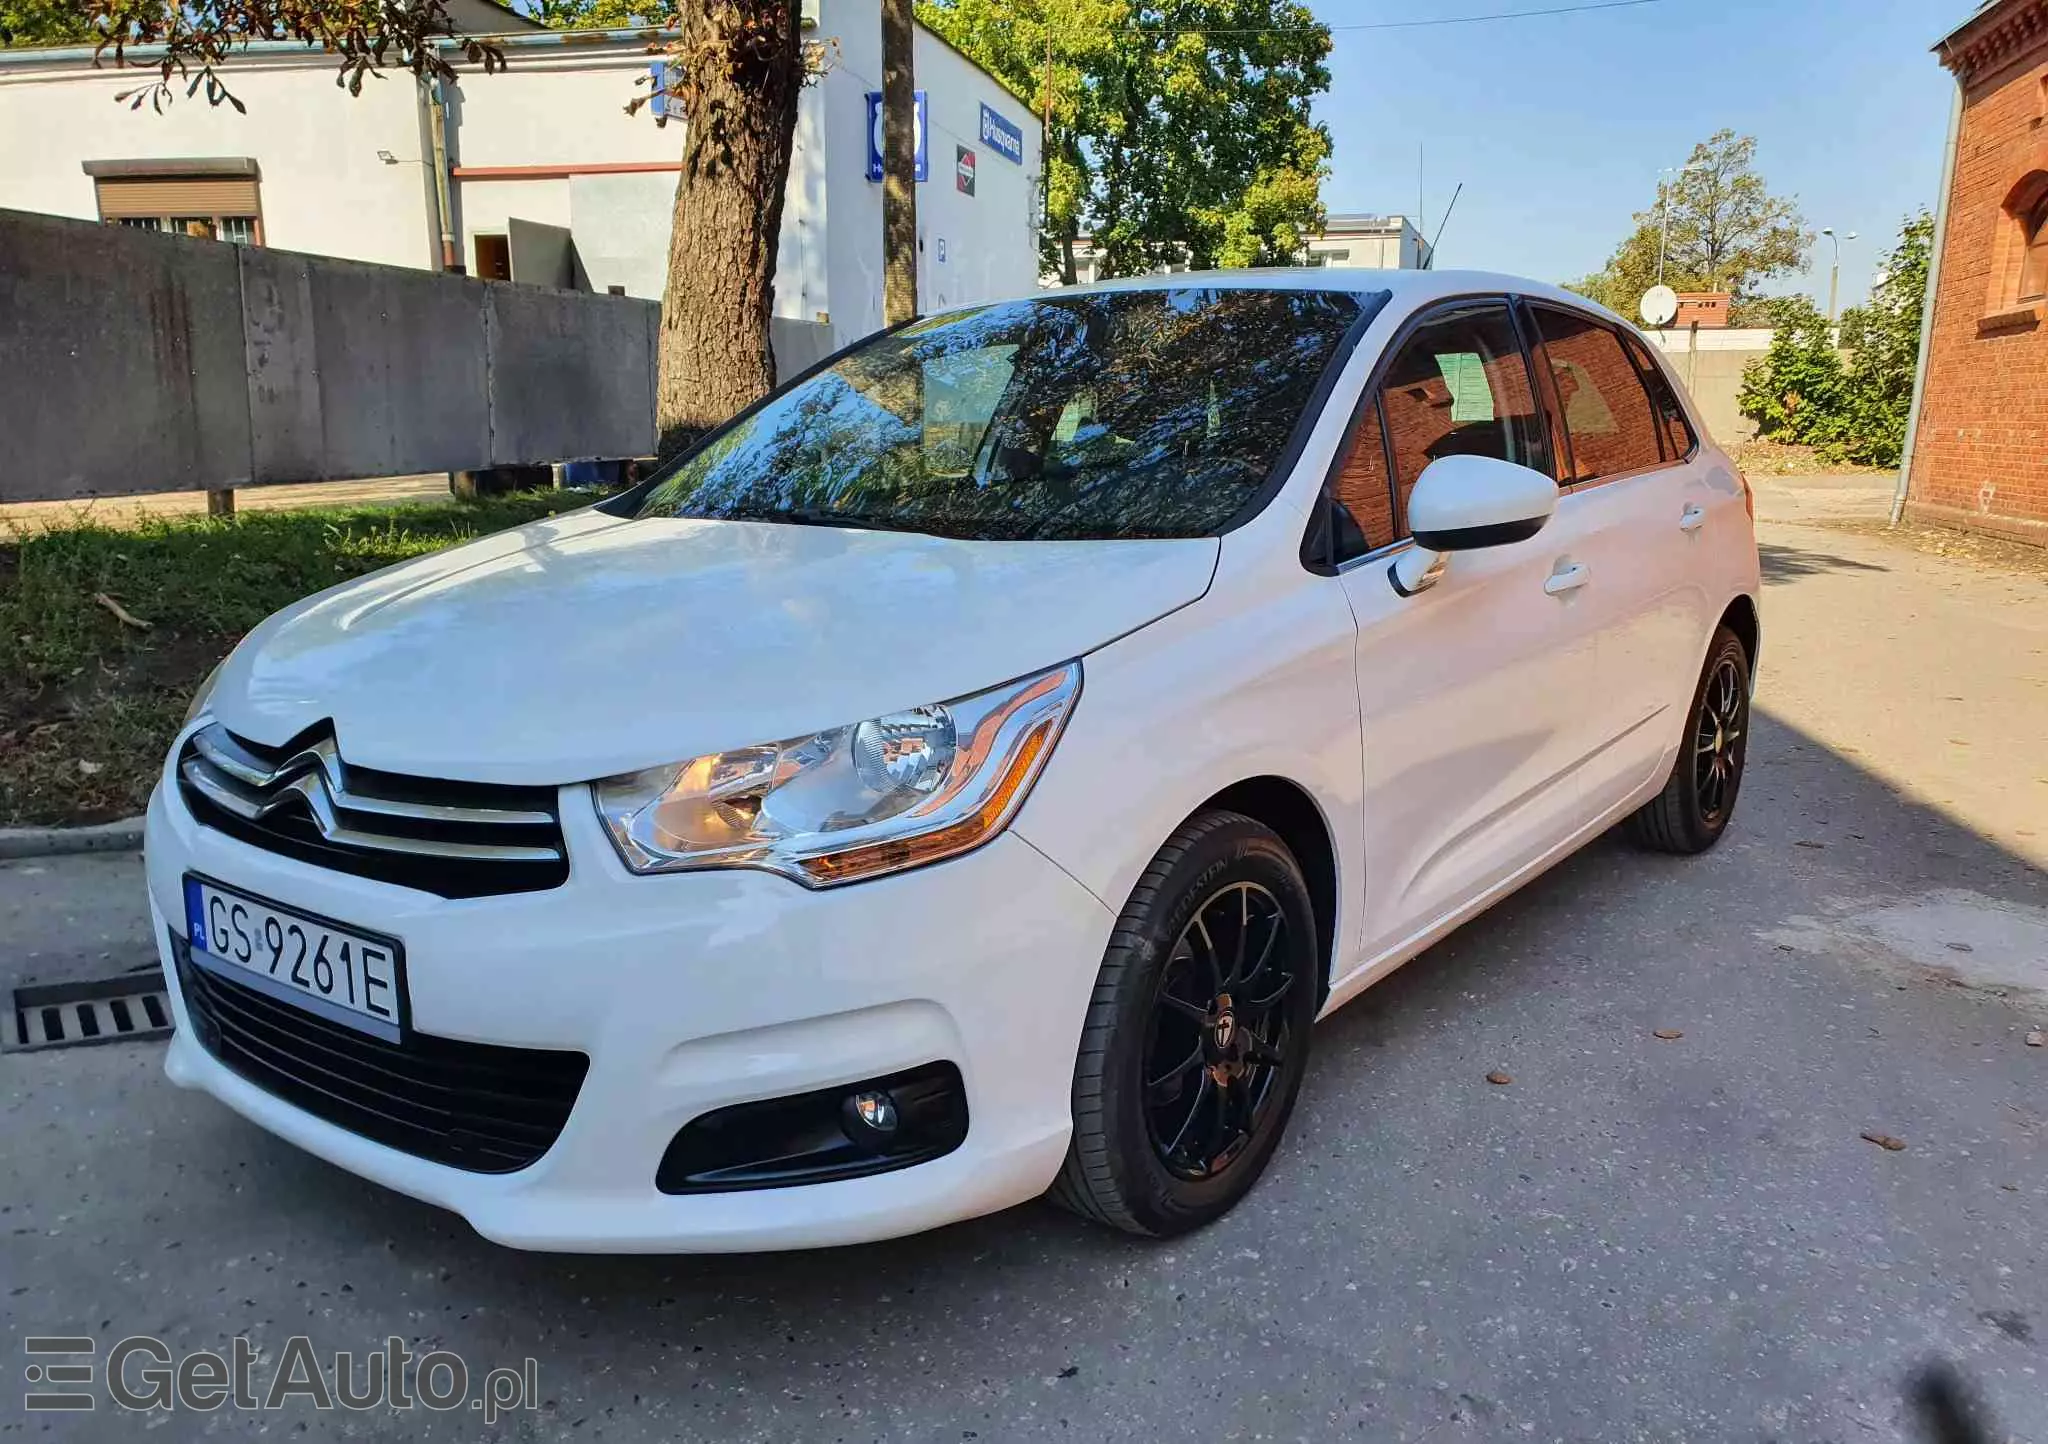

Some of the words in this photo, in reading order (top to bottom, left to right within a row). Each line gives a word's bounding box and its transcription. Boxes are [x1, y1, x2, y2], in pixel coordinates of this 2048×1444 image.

[193, 922, 205, 941] PL
[209, 895, 251, 964] GS
[264, 916, 391, 1018] 9261E
